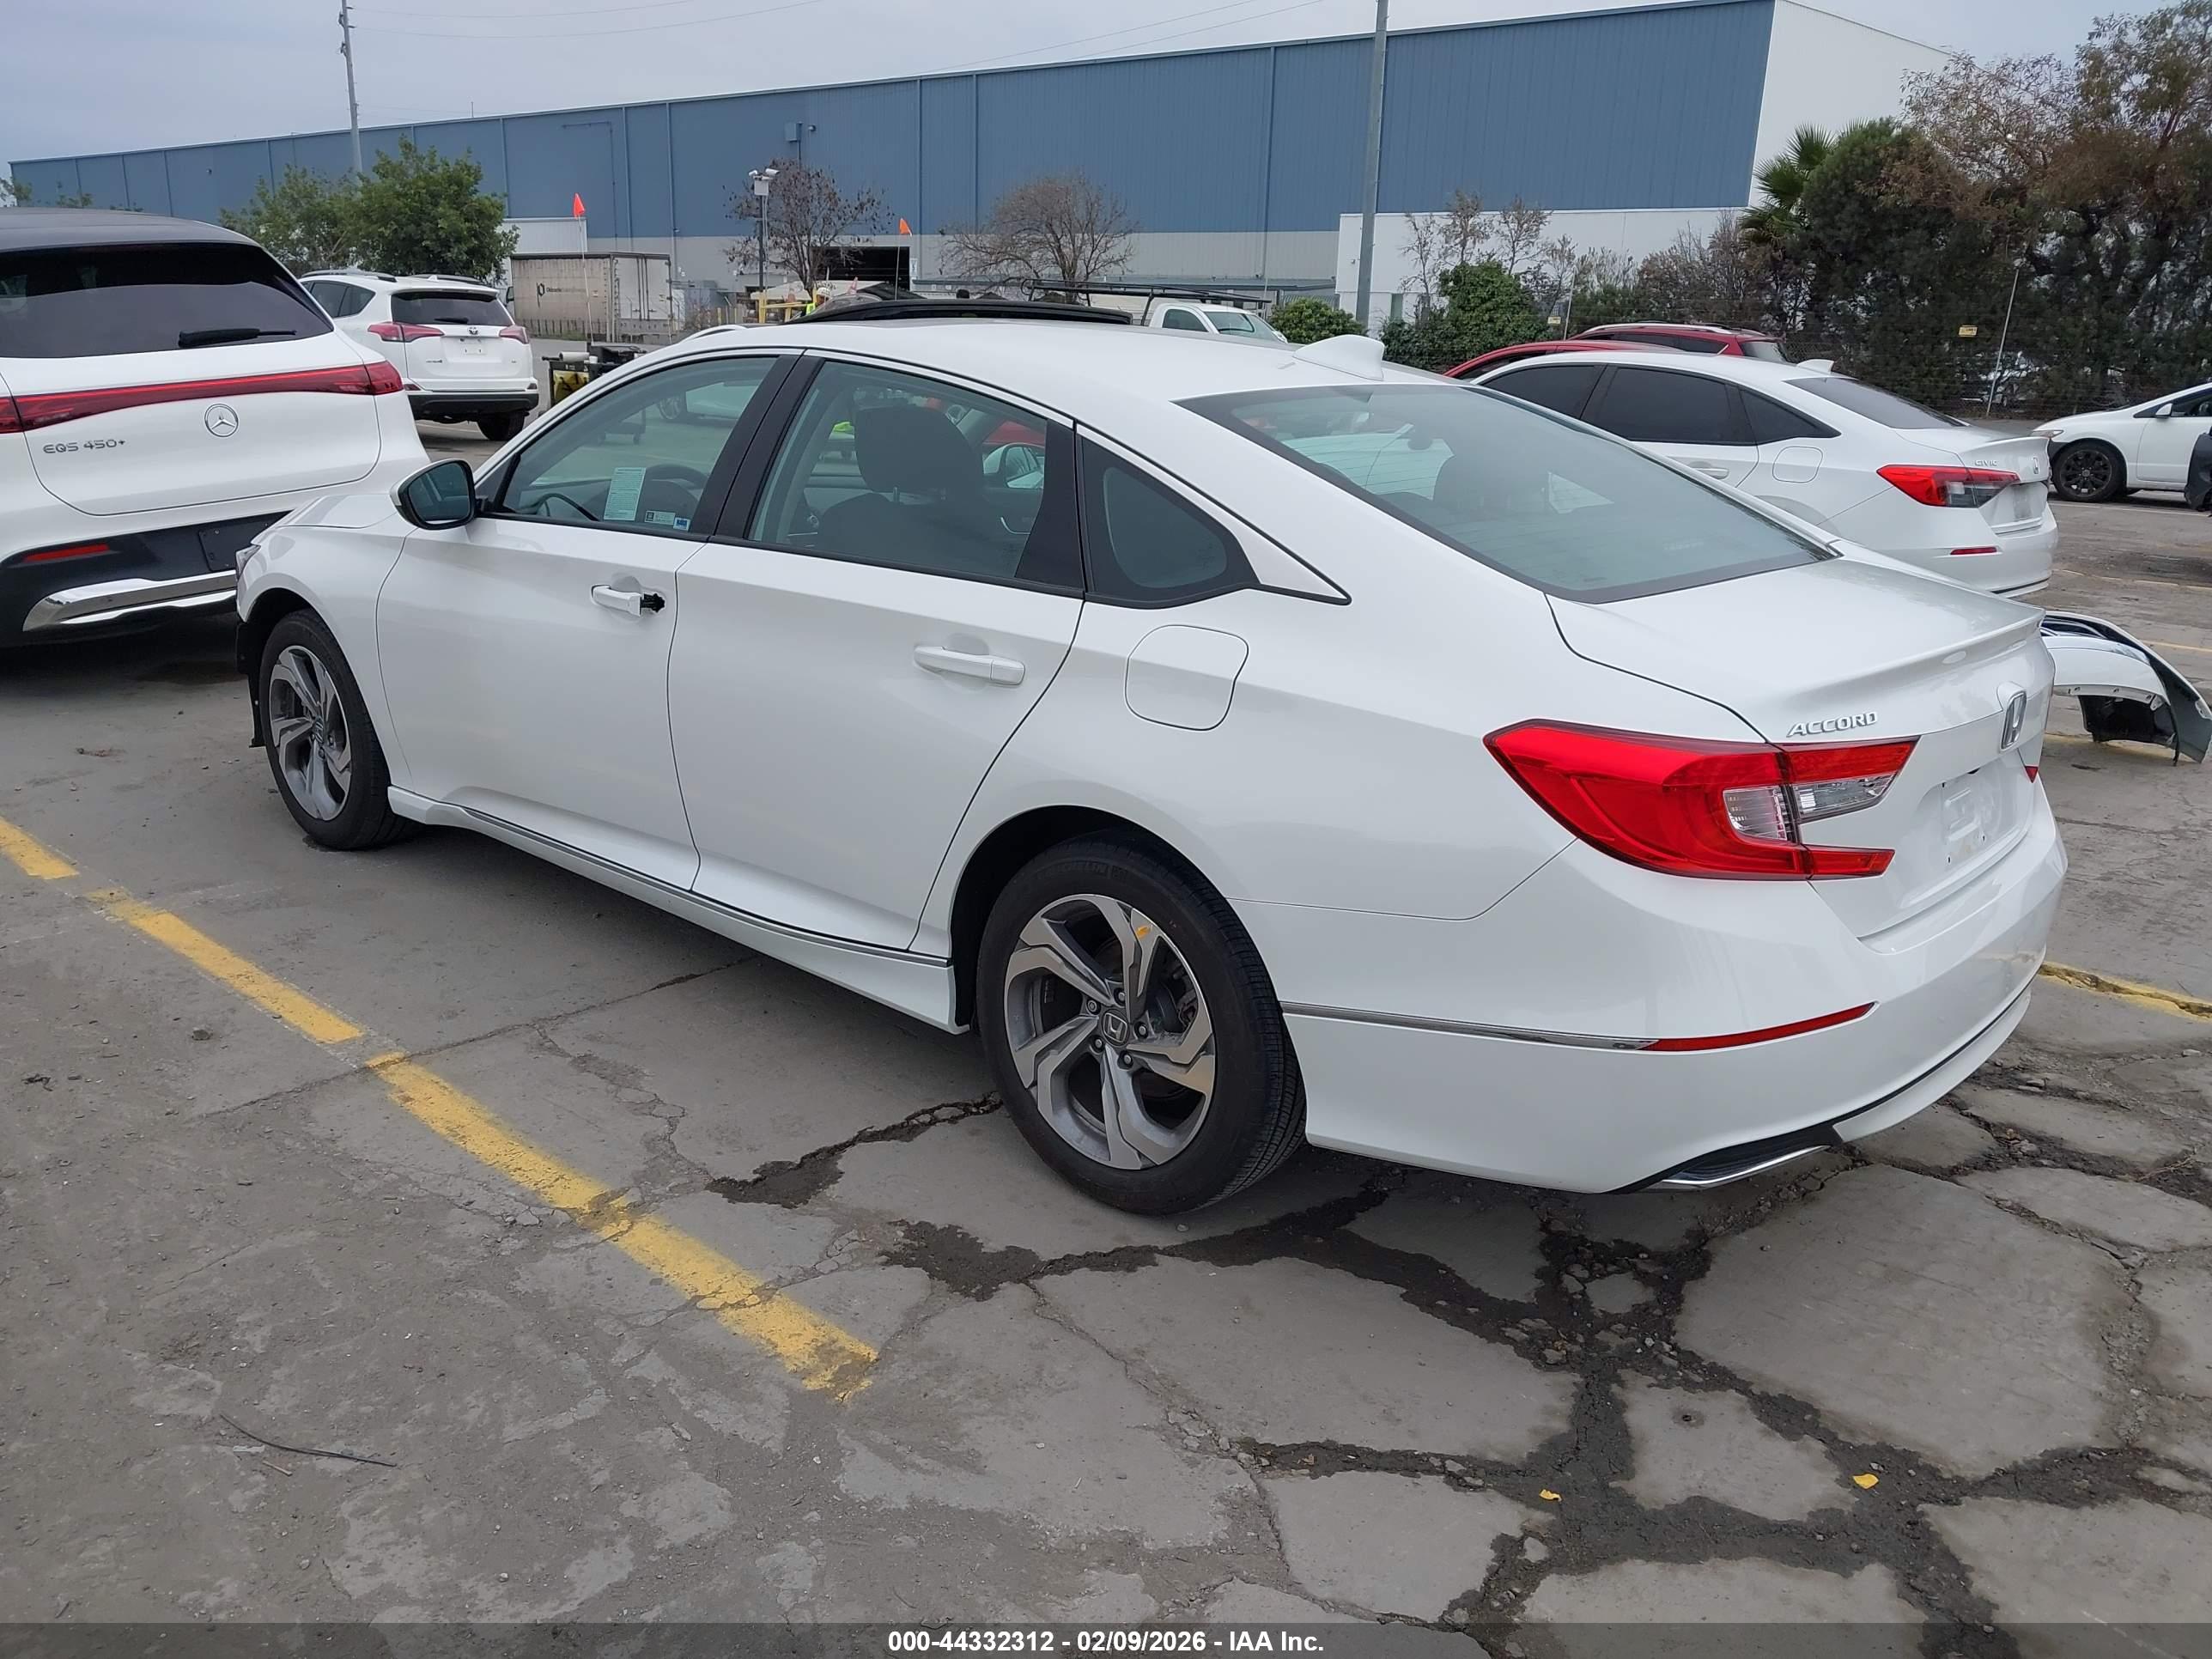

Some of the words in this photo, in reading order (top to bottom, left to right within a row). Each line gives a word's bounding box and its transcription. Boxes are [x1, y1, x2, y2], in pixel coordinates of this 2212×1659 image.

[43, 442, 79, 454] EQS
[83, 438, 126, 450] 450+
[1974, 459, 1998, 467] CIVIC
[1786, 711, 1879, 738] ACCORD
